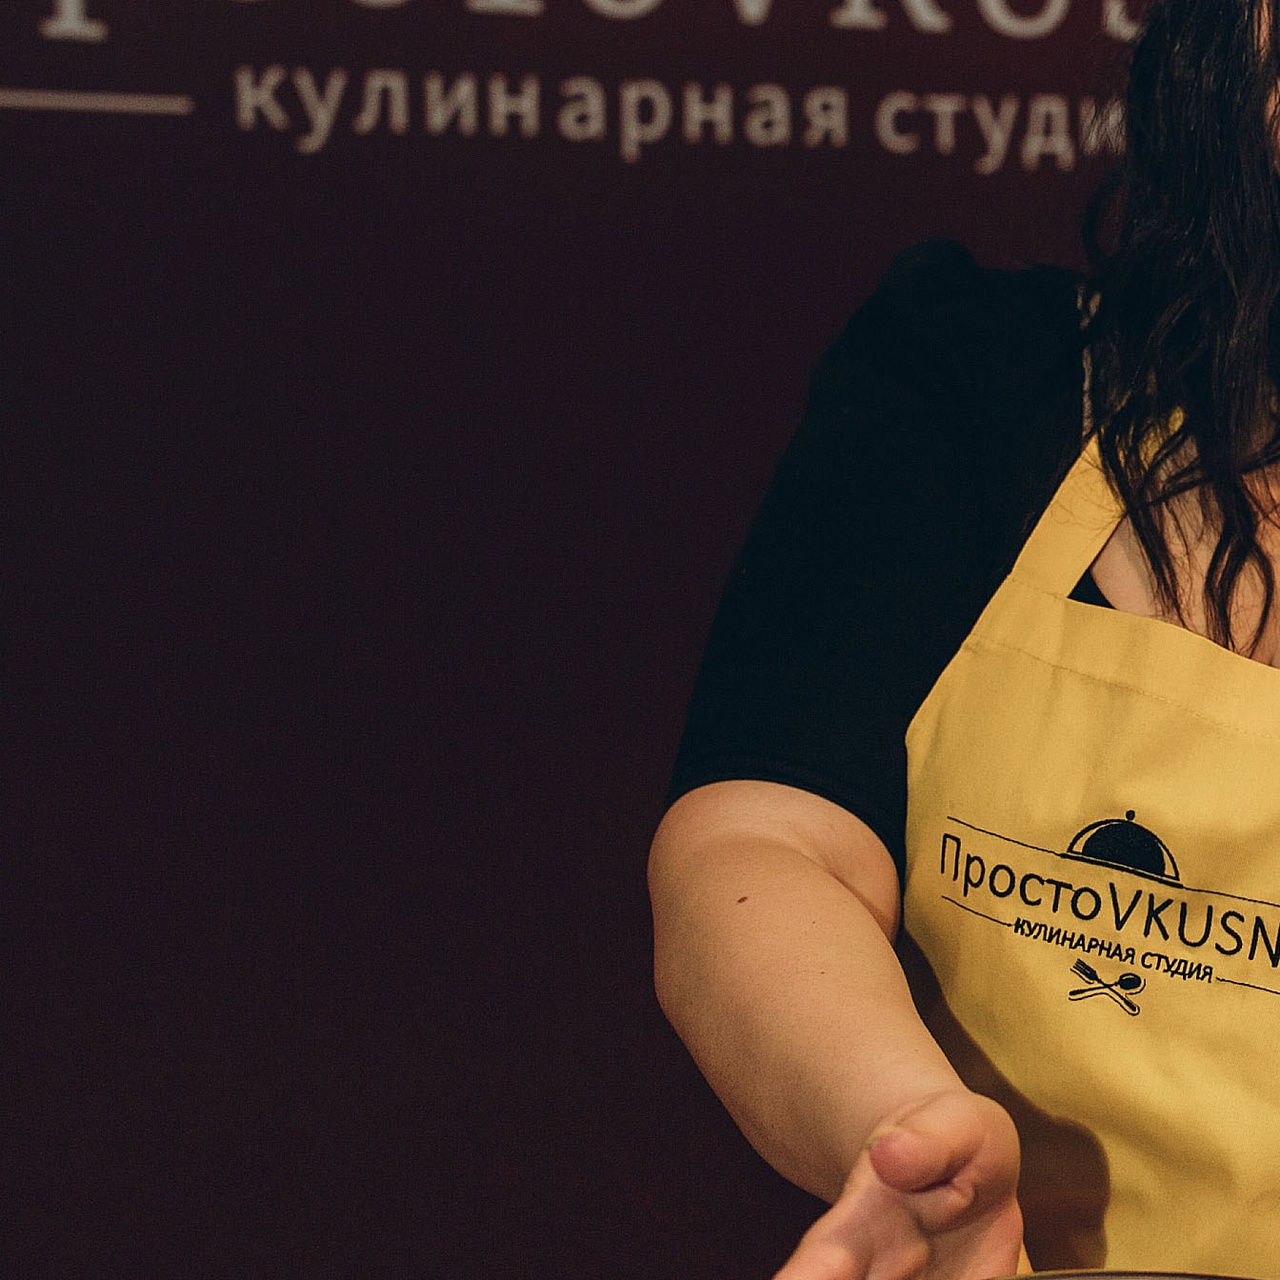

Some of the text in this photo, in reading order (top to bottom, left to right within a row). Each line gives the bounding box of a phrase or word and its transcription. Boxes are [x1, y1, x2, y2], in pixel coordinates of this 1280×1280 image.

[235, 65, 1127, 174] кулинарная студи
[1013, 917, 1213, 983] КУЛИНАРНАЯ СТУДИЯ
